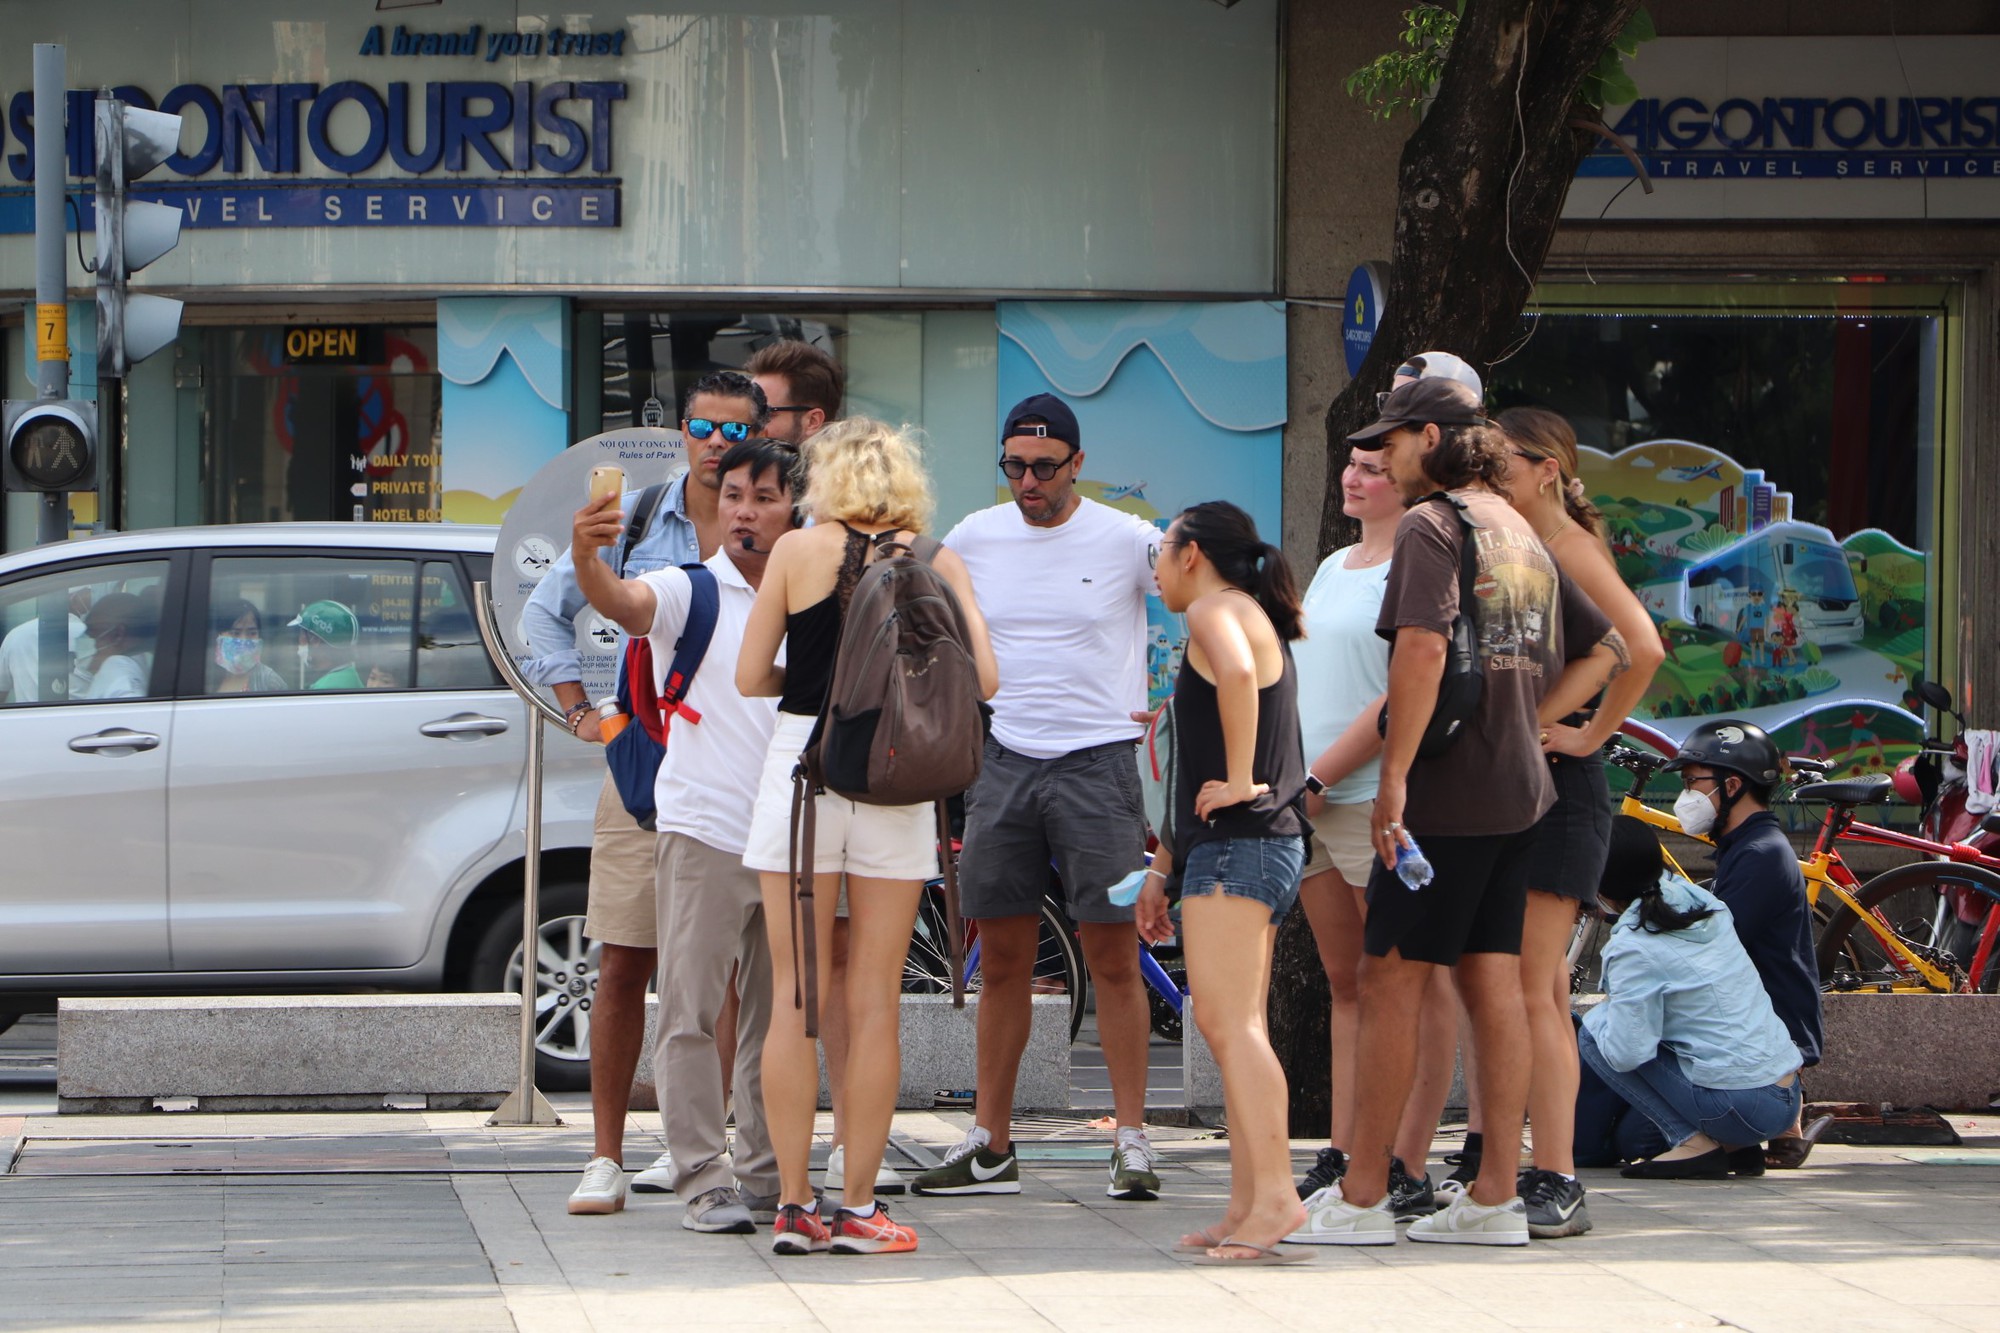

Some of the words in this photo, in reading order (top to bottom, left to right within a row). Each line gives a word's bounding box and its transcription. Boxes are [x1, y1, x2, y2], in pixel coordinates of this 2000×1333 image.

[359, 25, 384, 55] A
[390, 25, 482, 56] brand
[485, 32, 543, 62] you
[547, 28, 626, 56] trust
[8, 81, 627, 181] SIONTOURIST
[1597, 97, 2000, 149] AIGONTOURIS
[1661, 161, 1801, 175] TRAVEL
[1837, 160, 2000, 175] SERVICE
[325, 195, 599, 221] SERVICE
[45, 322, 55, 340] 7
[287, 329, 356, 357] OPEN
[618, 440, 637, 449] QUY
[668, 439, 684, 449] VIÊ
[373, 454, 409, 467] DAILY
[619, 451, 643, 459] Rules
[646, 451, 655, 459] of
[656, 451, 676, 459] Park
[373, 482, 425, 494] PRIVATE
[373, 508, 412, 521] HOTEL
[417, 508, 442, 521] BOO
[311, 615, 333, 634] Grab
